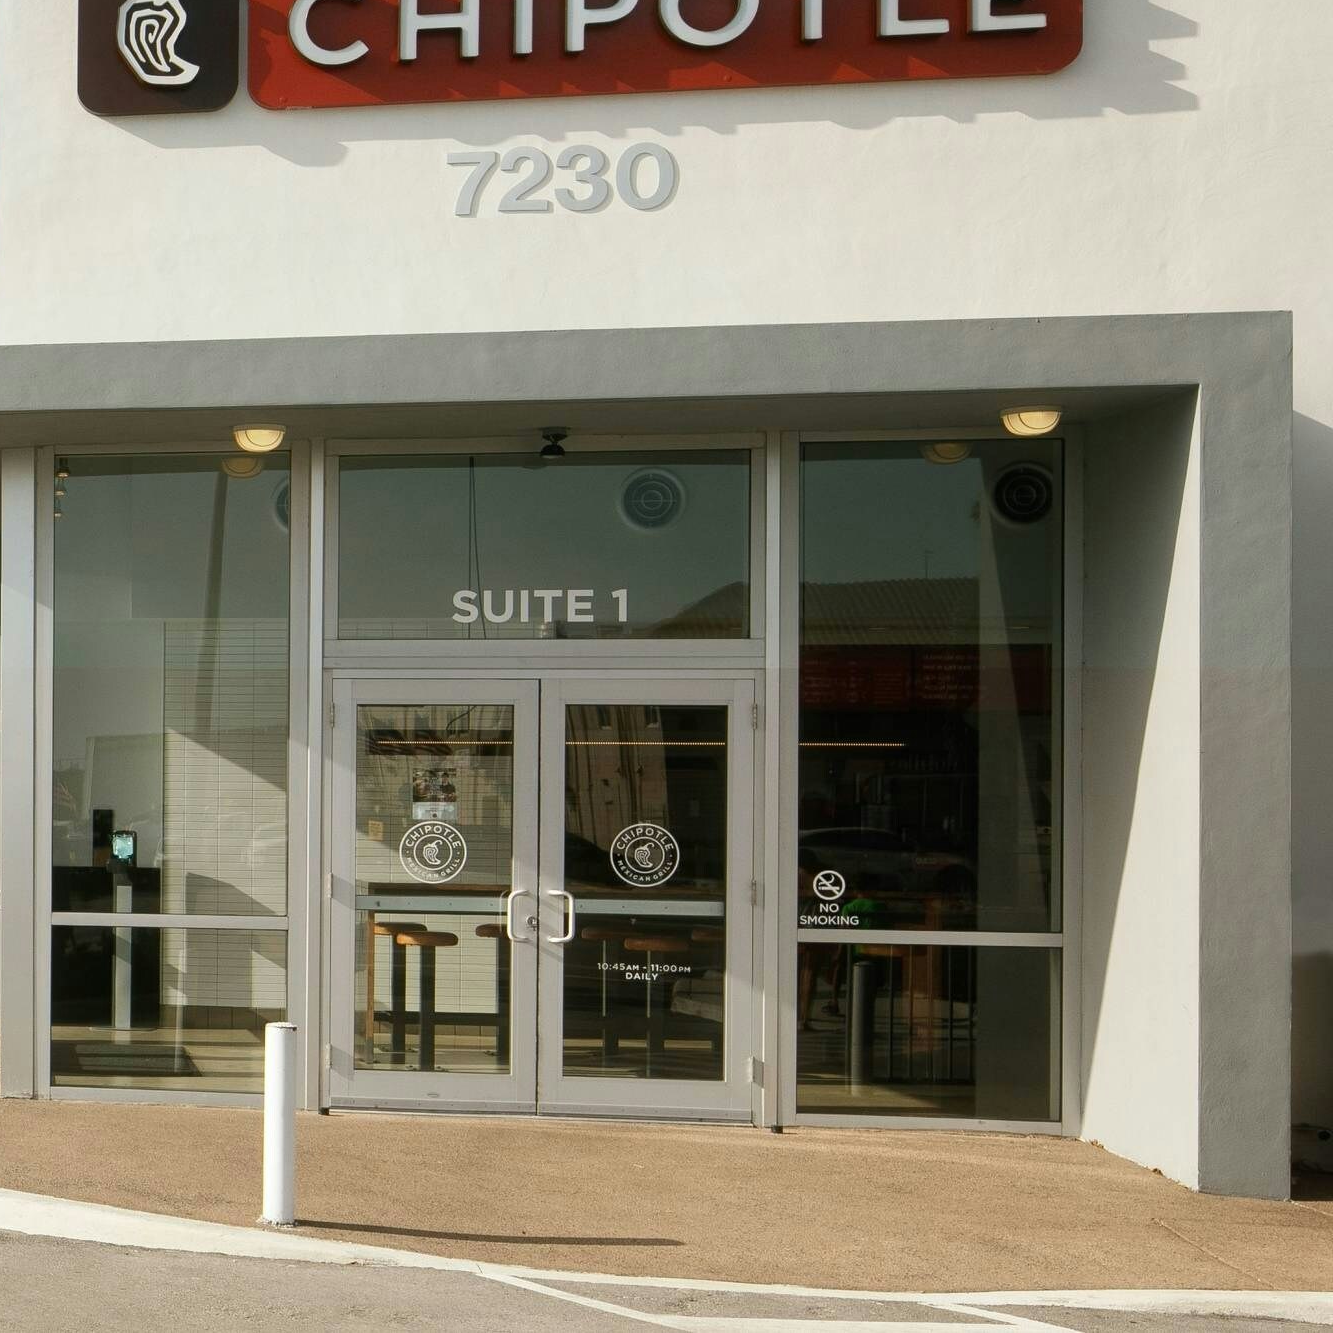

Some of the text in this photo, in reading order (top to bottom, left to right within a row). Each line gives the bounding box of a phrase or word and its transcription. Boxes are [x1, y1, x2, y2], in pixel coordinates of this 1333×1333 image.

[446, 142, 679, 217] 7230
[452, 588, 628, 624] SUITE 1
[405, 825, 462, 849] CHIPOTLE
[616, 827, 674, 851] CHIPOTLE
[440, 858, 461, 877] GRILL
[617, 860, 673, 882] MEXICAN GRILL
[819, 903, 839, 913] NO
[799, 915, 860, 926] SMOKING
[597, 962, 640, 971] 10:45AM
[625, 972, 659, 981] DAILY
